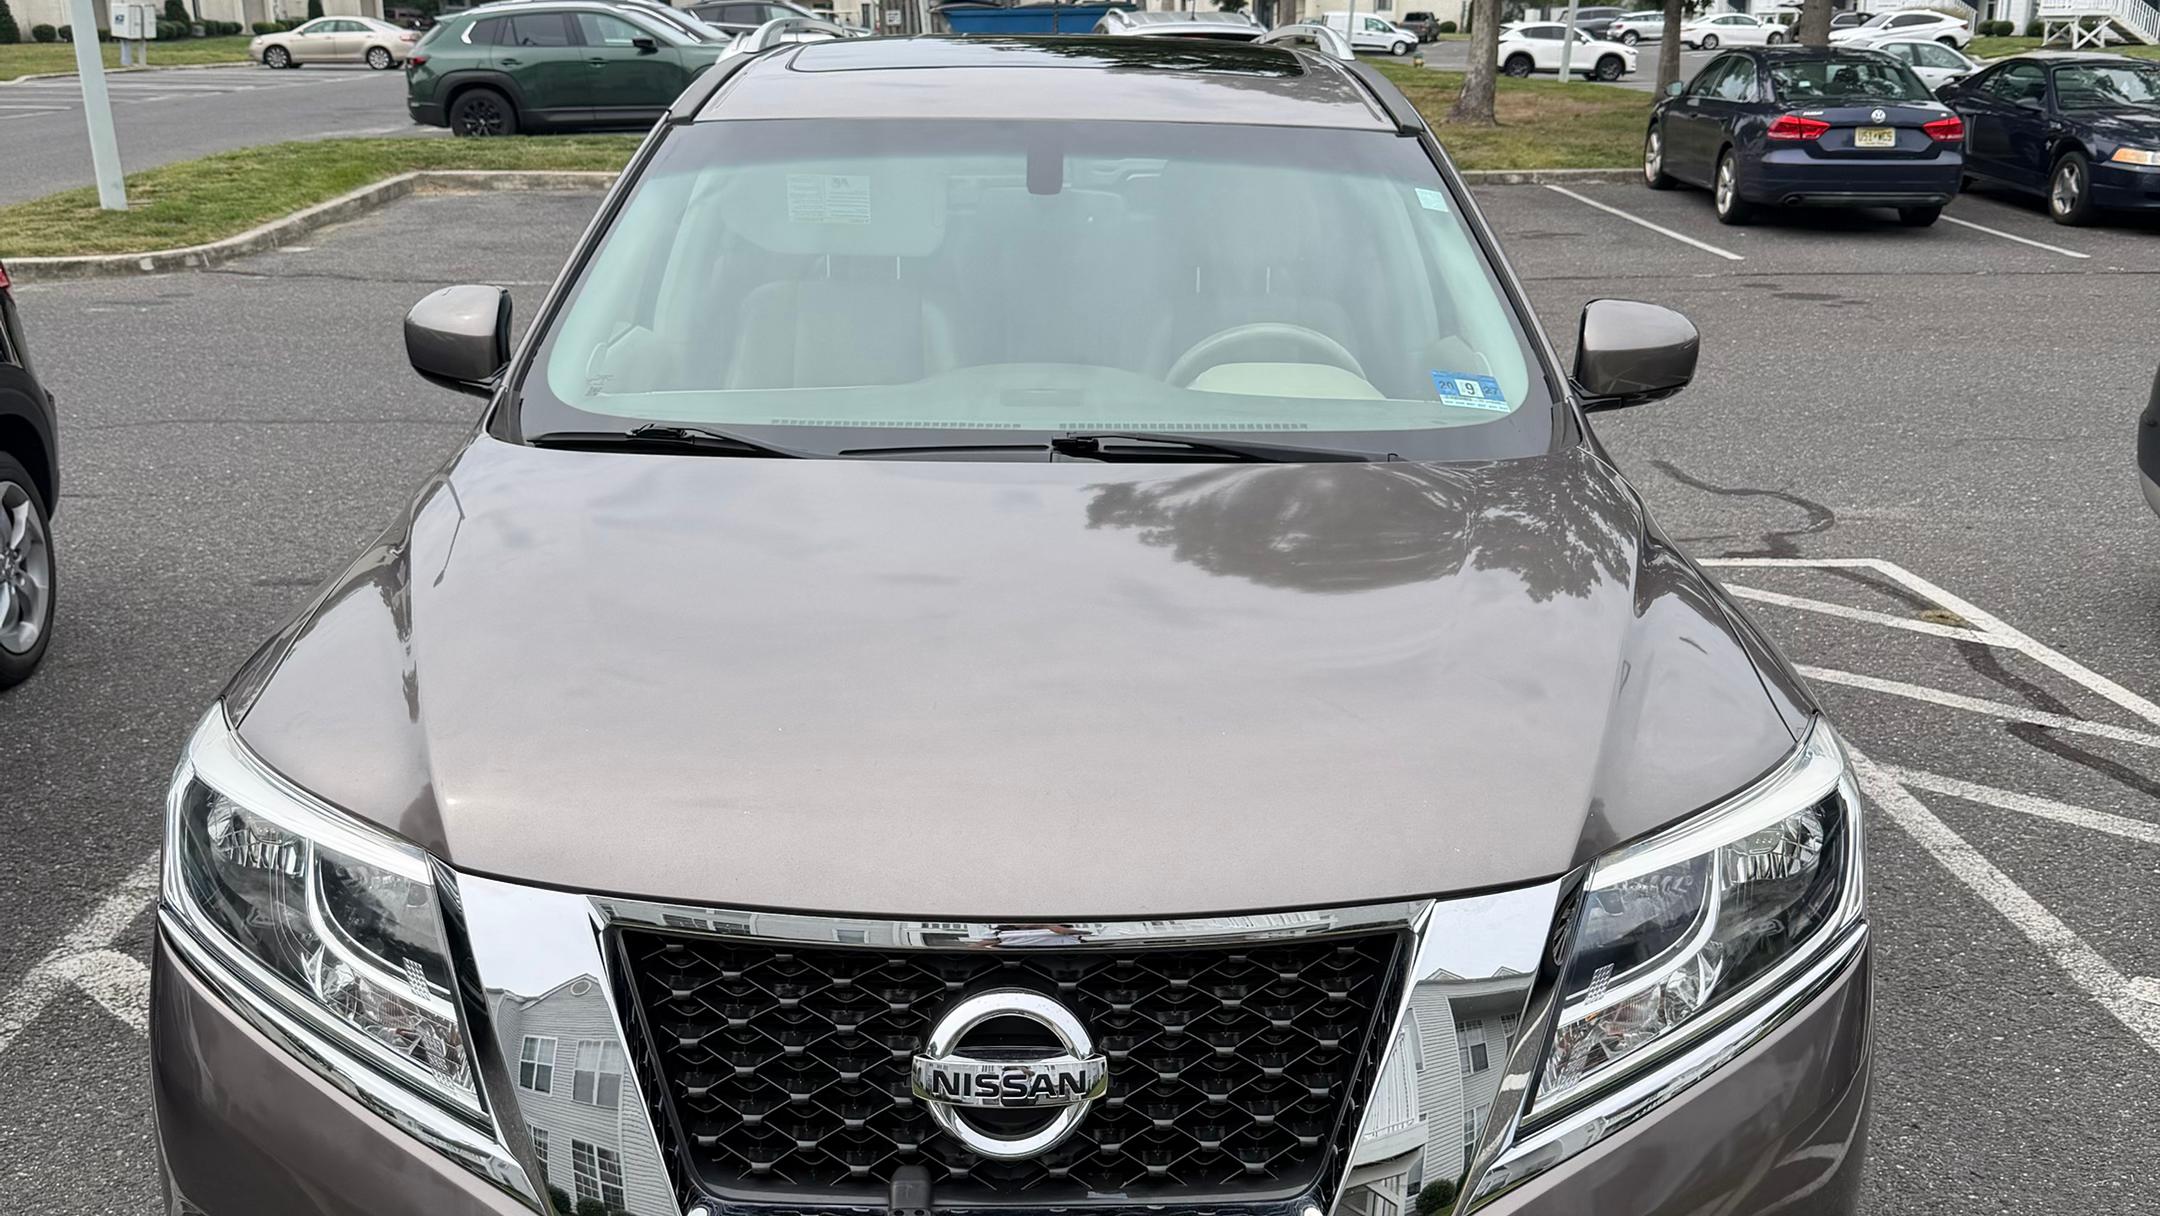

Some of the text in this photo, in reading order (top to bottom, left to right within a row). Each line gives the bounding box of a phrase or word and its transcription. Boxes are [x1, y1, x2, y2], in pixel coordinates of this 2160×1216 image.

[1439, 380, 1455, 390] 20
[1464, 382, 1476, 396] 9
[932, 1069, 1087, 1100] NISSAN
